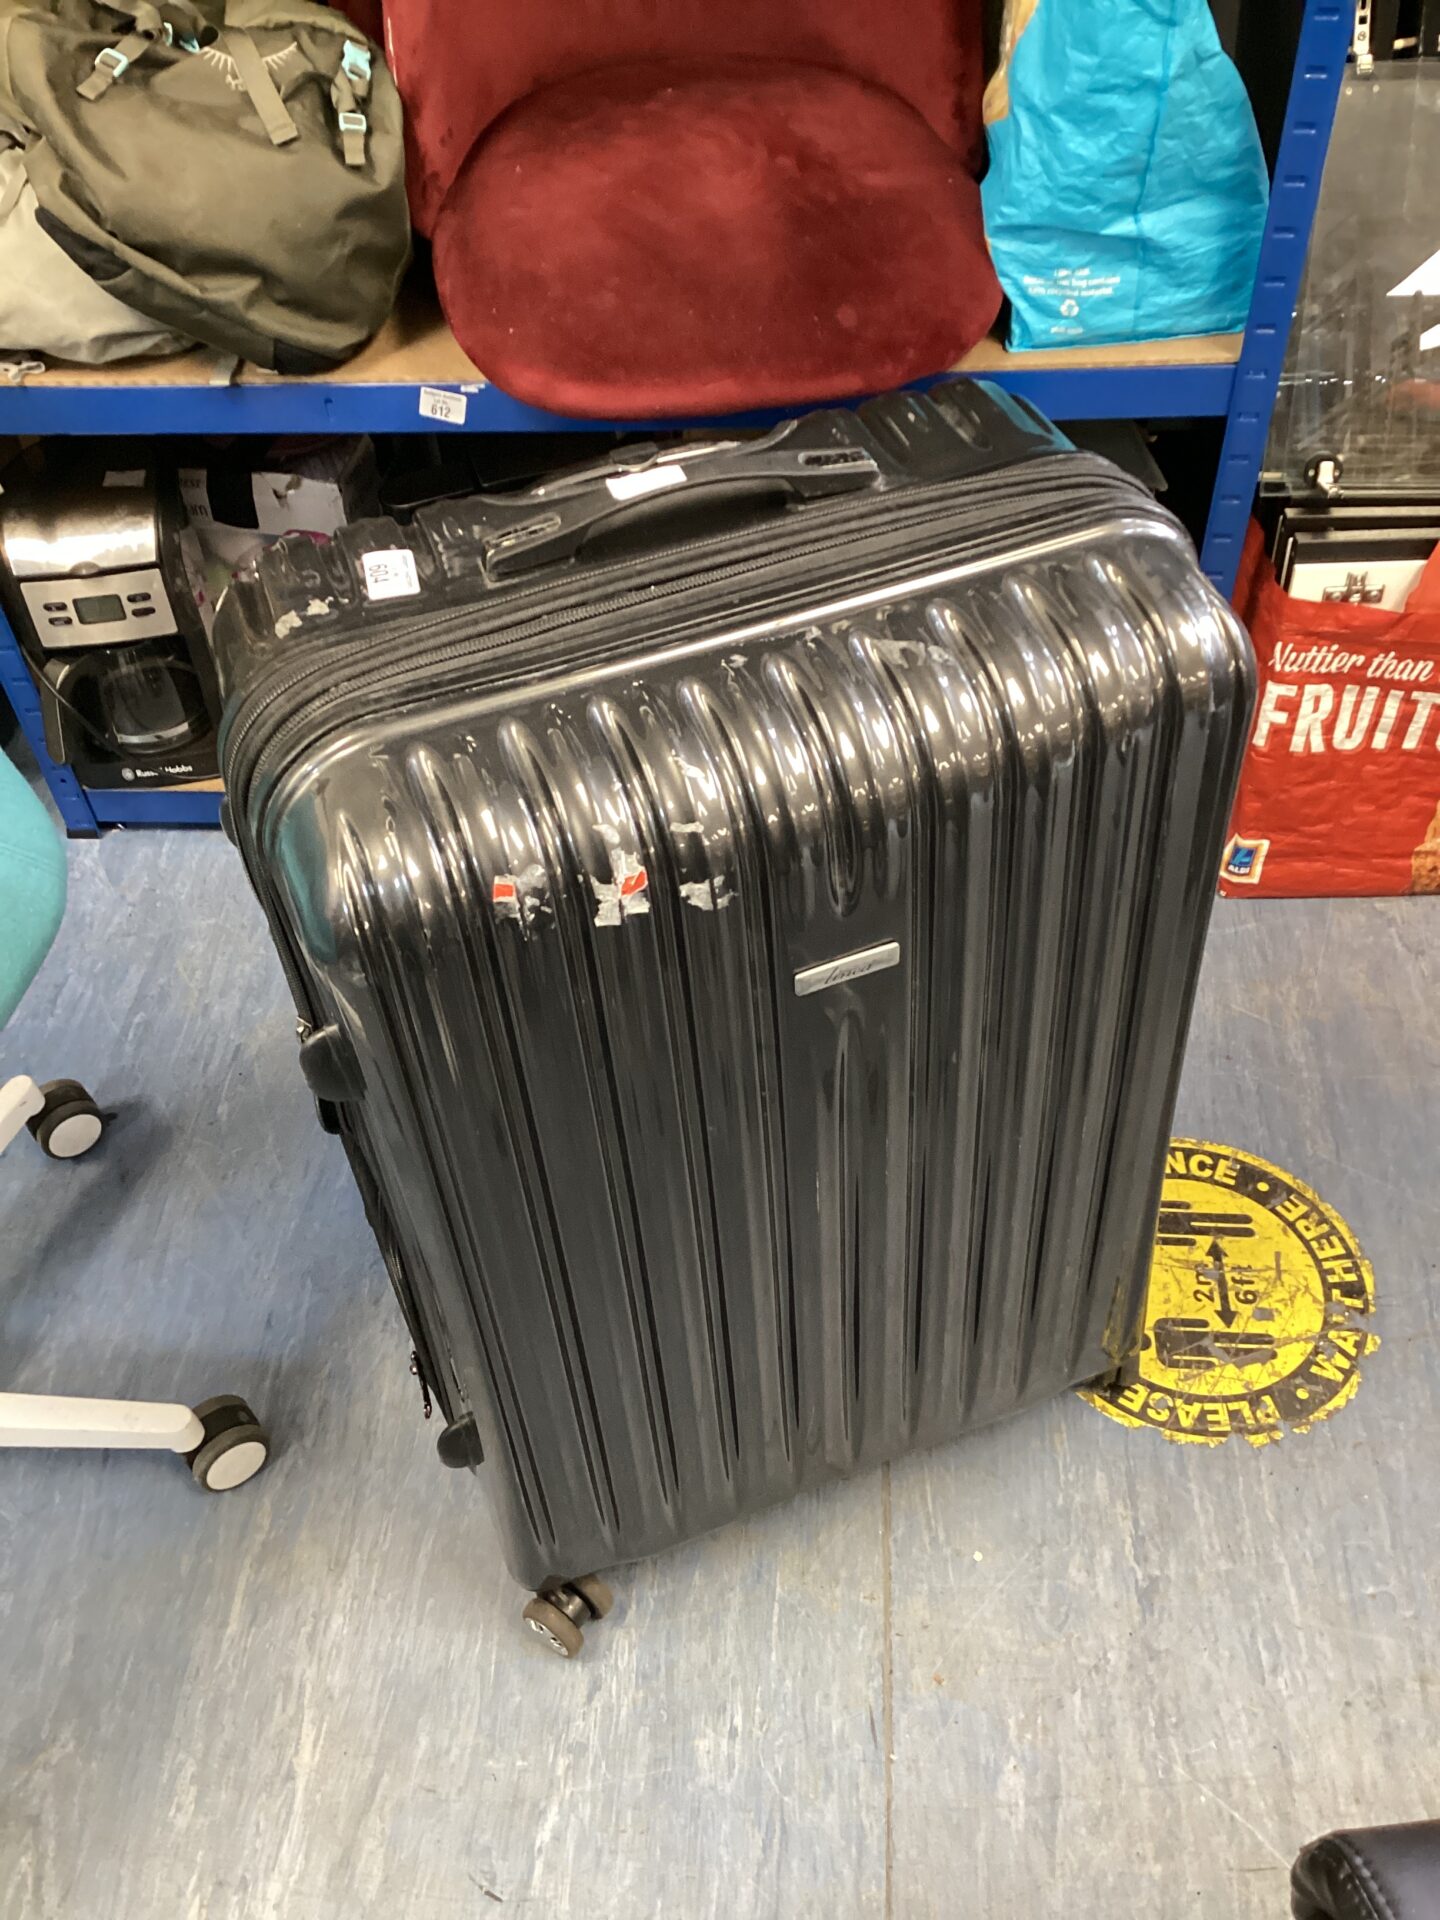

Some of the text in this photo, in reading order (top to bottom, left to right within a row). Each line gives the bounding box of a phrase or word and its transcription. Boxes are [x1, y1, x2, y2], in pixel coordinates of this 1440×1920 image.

[431, 403, 451, 419] 612
[1268, 641, 1366, 674] Nuttier
[1366, 651, 1435, 682] than
[1252, 680, 1440, 753] FRUIT
[1164, 1151, 1240, 1185] NCE
[1310, 1289, 1364, 1382] WAT
[1117, 1383, 1282, 1431] PLEASE
